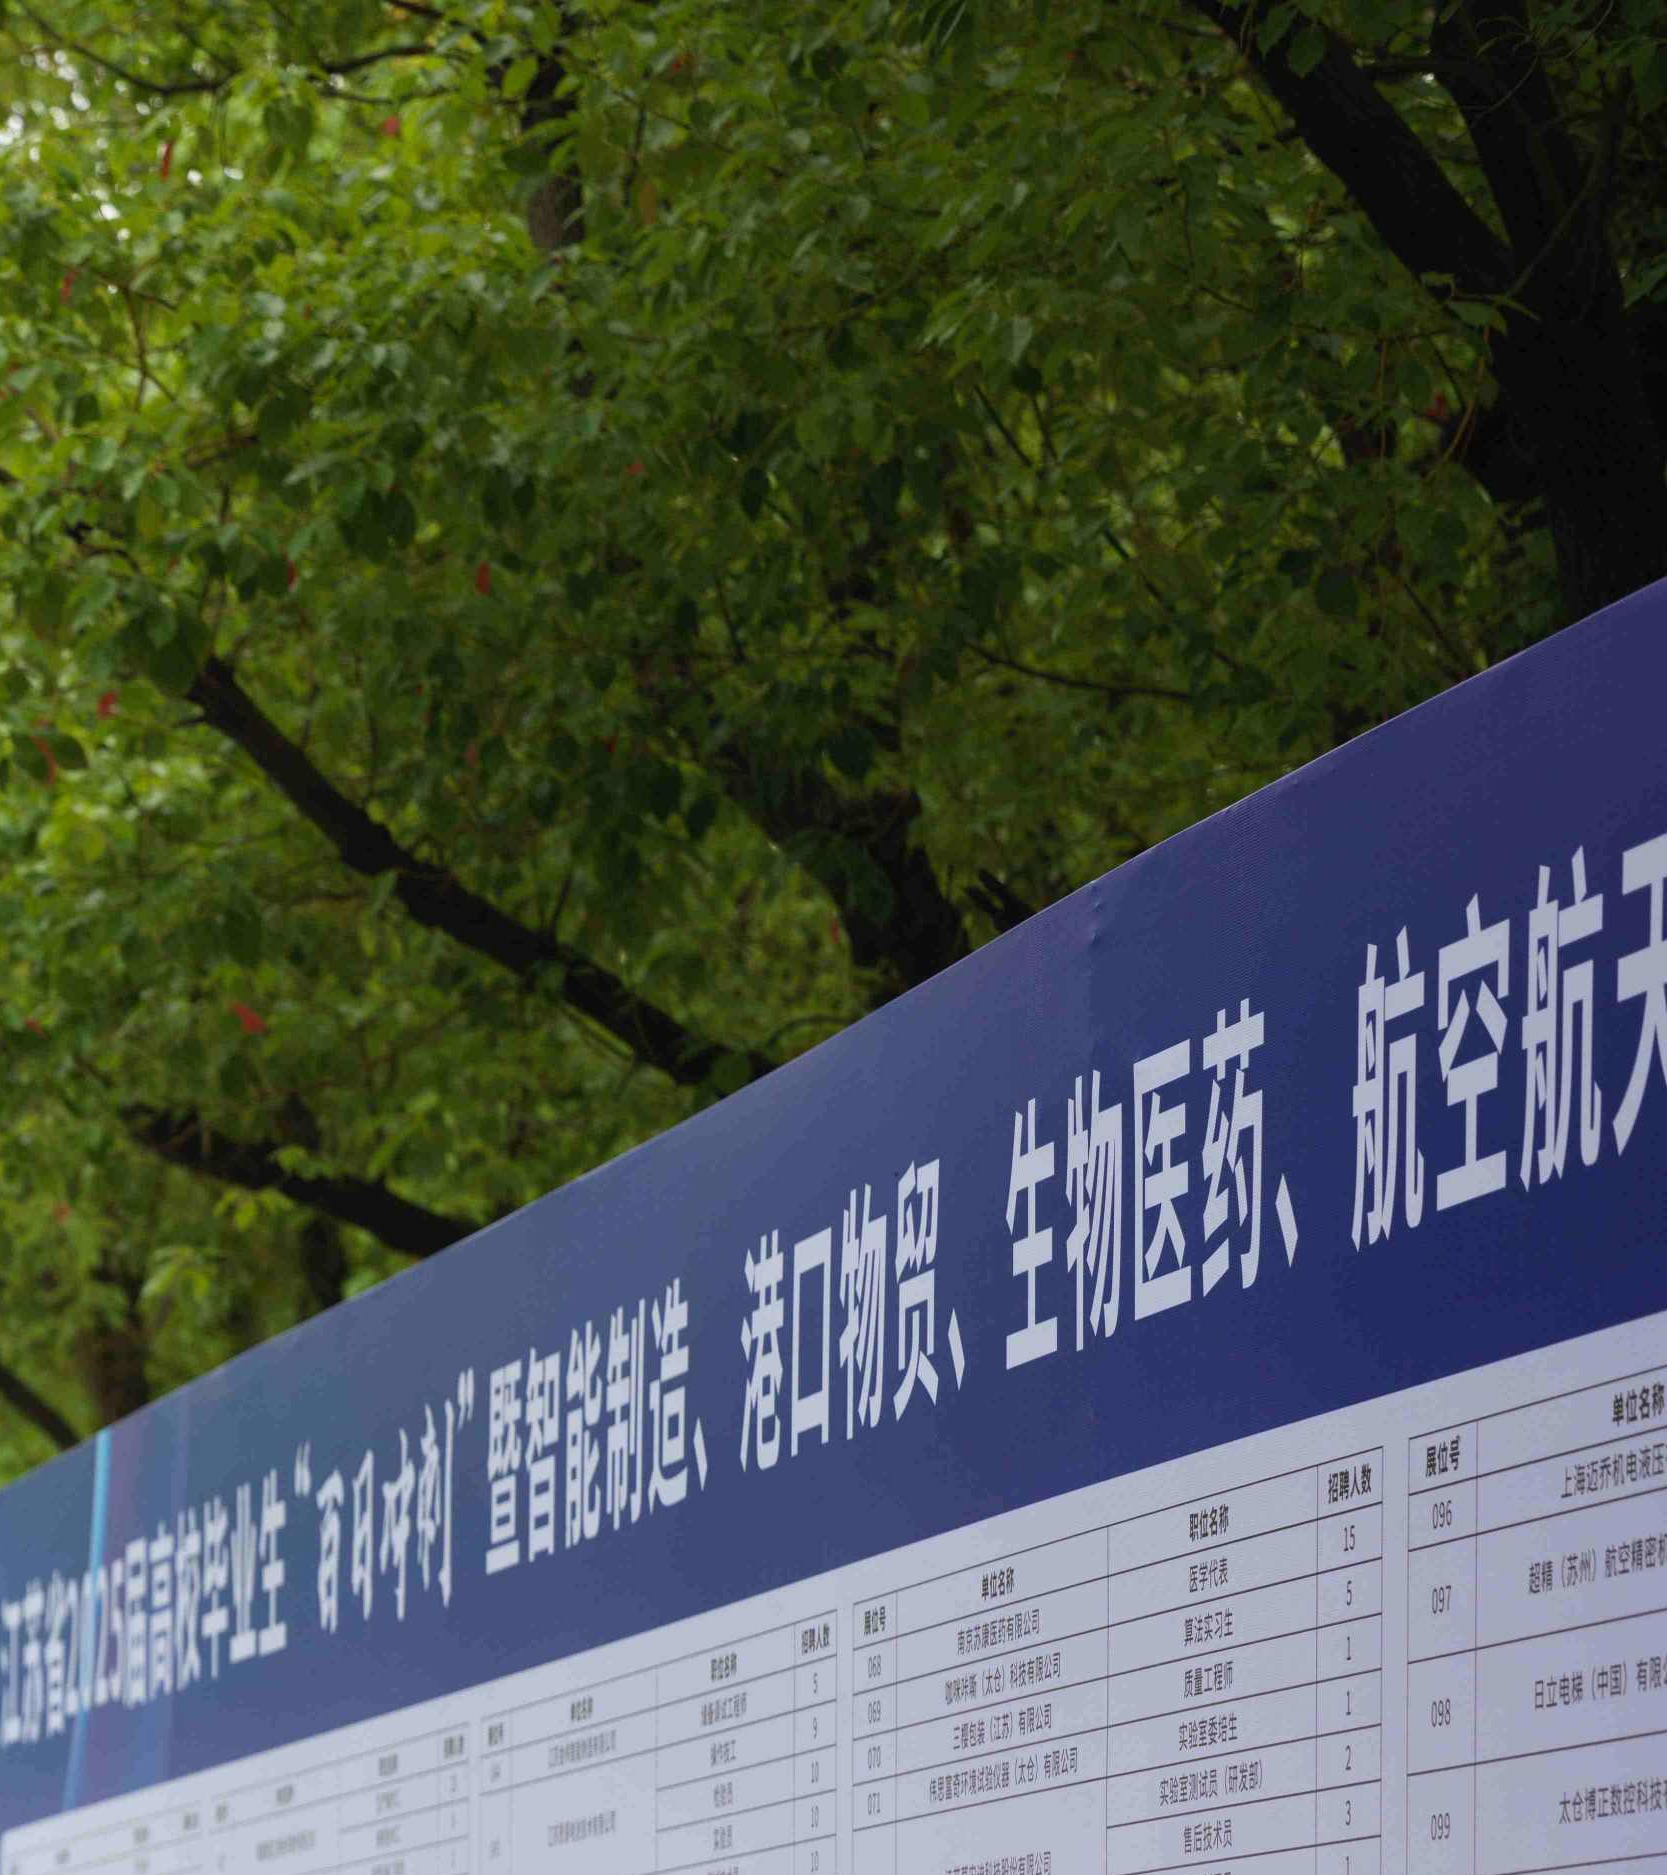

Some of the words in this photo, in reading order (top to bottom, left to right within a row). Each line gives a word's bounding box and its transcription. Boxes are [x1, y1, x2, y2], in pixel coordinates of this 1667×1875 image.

[1612, 1371, 1667, 1426] 单位名称
[1425, 1435, 1460, 1477] 展位号
[1560, 1432, 1667, 1499] 上海迈乔机电液压
[1328, 1464, 1372, 1504] 招聘人数
[1189, 1504, 1229, 1542] 职位名称
[1432, 1499, 1453, 1530] 096
[1343, 1524, 1356, 1553] 15
[981, 1566, 1015, 1601] 单位名称
[1189, 1557, 1229, 1593] 医学代表
[1431, 1584, 1452, 1615] 097
[1184, 1610, 1234, 1647] 算法实习生
[1183, 1660, 1234, 1698] 质量工程师
[1431, 1697, 1451, 1728] 098
[1178, 1713, 1238, 1751] 实验室委培生
[1559, 1768, 1667, 1823] 太仓博正数控科技
[1183, 1818, 1233, 1854] 售后技术员
[1430, 1812, 1451, 1841] 099
